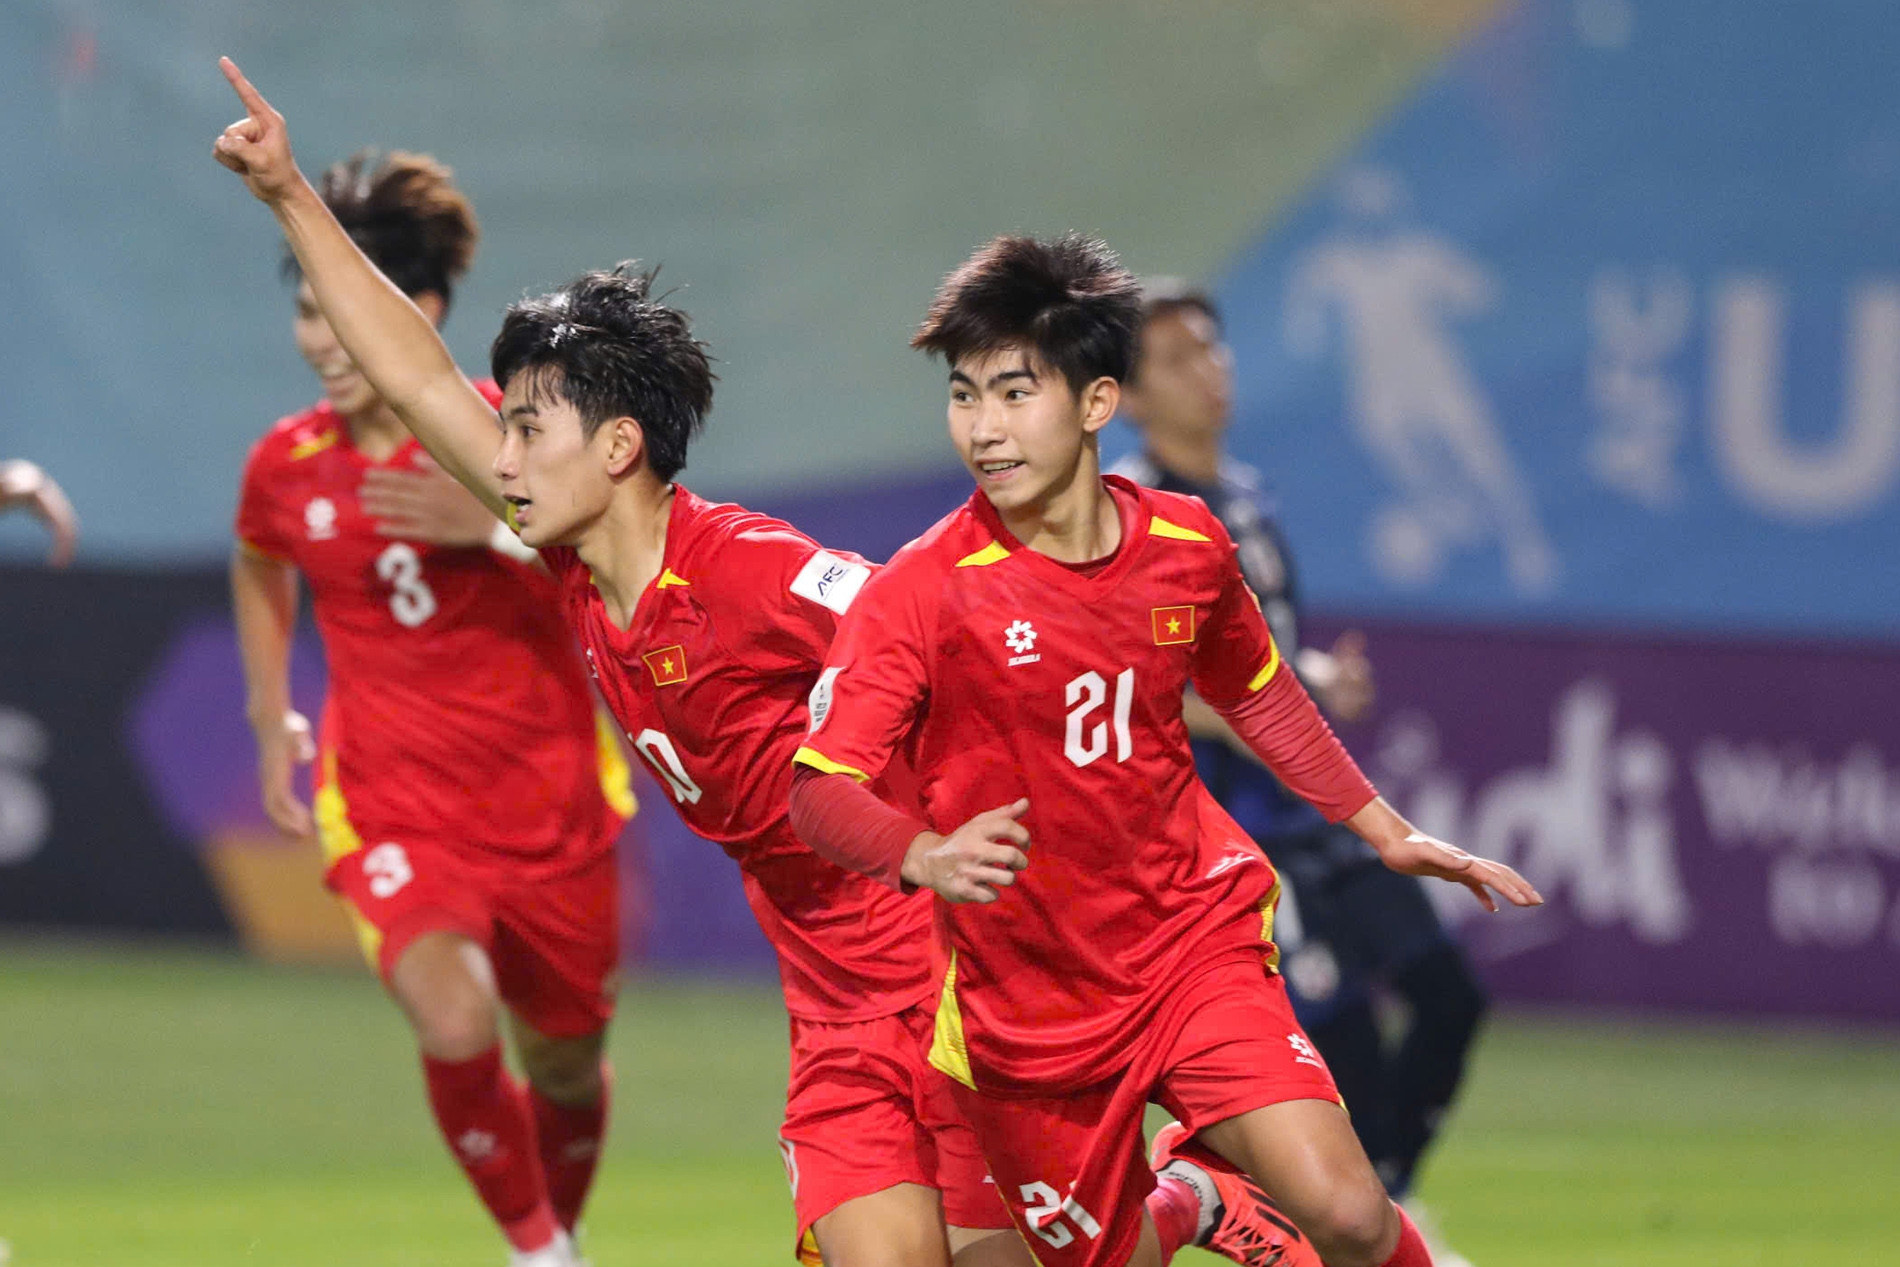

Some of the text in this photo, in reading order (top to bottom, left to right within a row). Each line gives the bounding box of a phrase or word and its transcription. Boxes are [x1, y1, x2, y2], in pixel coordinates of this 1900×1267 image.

[376, 543, 437, 627] 3
[817, 566, 844, 598] AFC
[1063, 666, 1135, 768] 21
[627, 728, 703, 805] 0
[362, 842, 414, 899] 3
[1019, 1179, 1103, 1250] 21
